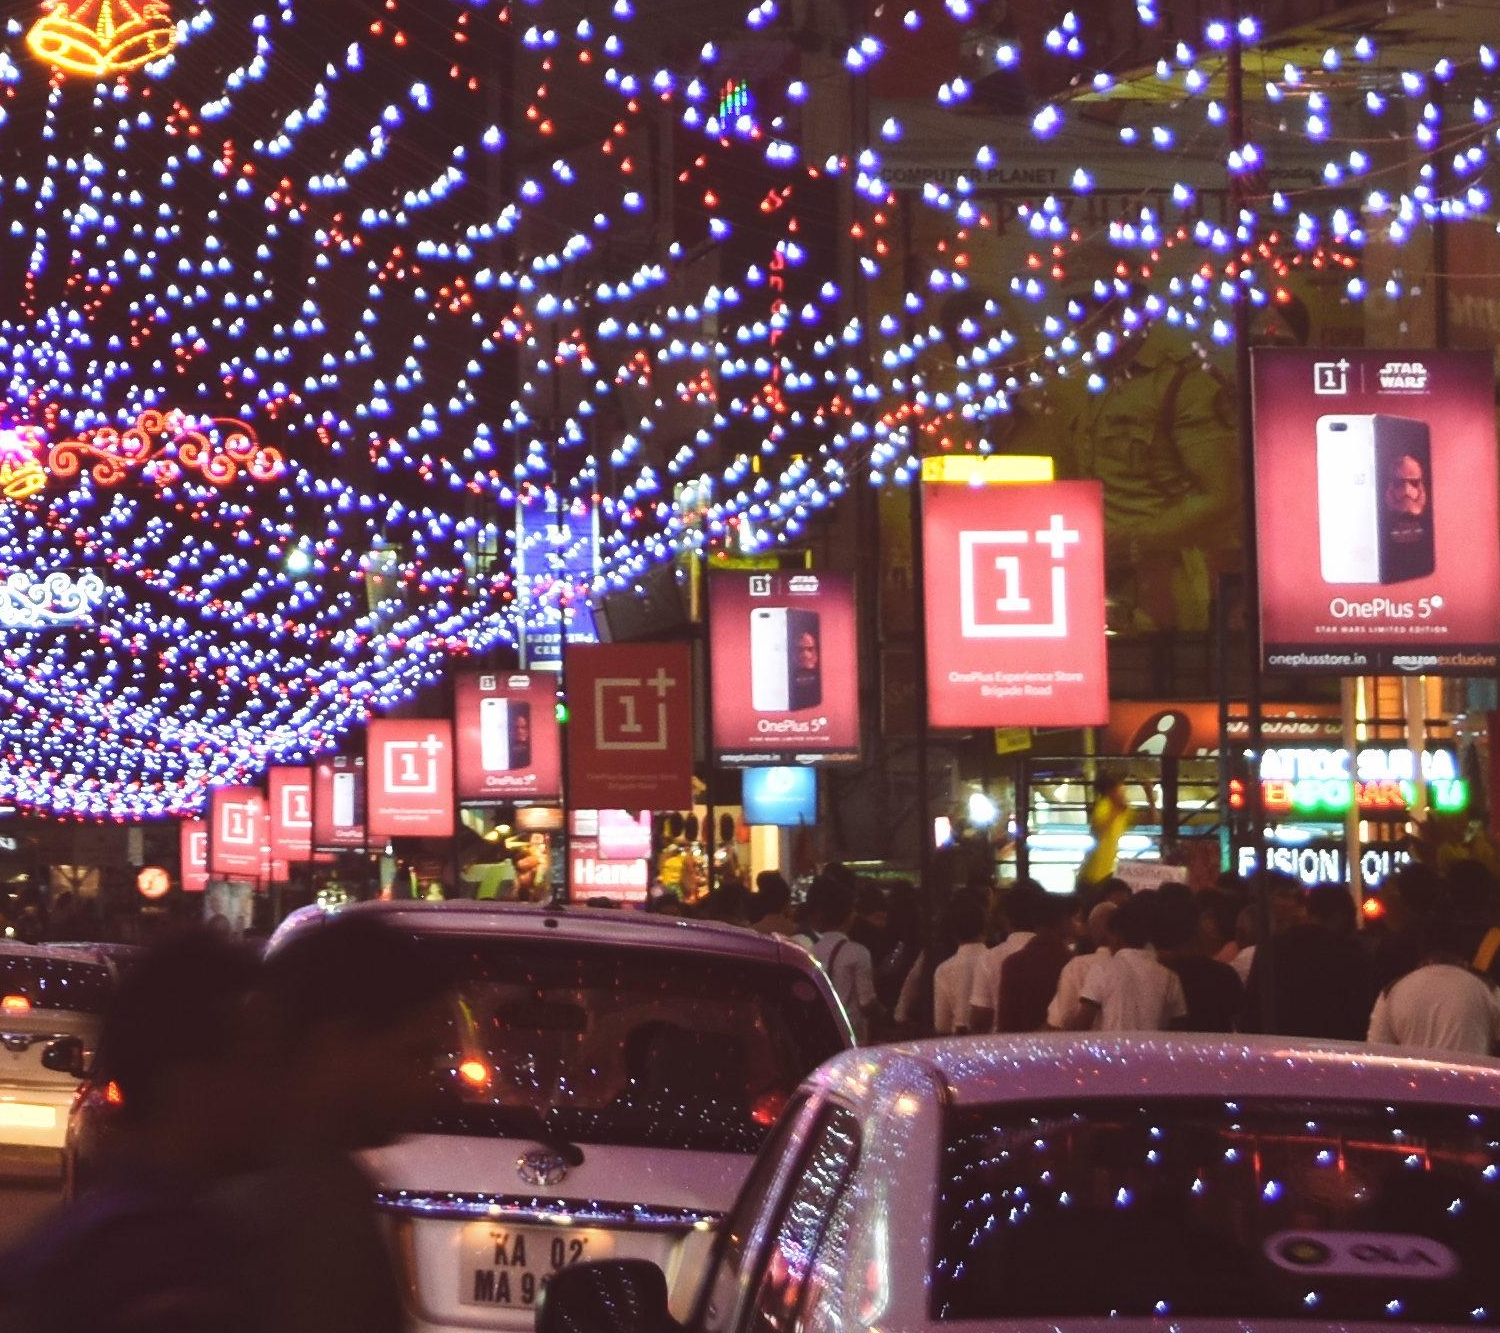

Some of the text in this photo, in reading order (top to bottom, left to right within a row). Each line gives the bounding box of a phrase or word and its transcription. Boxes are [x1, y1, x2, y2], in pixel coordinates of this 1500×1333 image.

[1379, 362, 1427, 375] STAR
[1379, 375, 1427, 390] WARS
[1330, 597, 1414, 620] OnePlus
[1268, 652, 1367, 668] oneplusstore.in
[949, 670, 1084, 685] OnePlus Experience Store
[980, 685, 1053, 699] Brigade Road
[575, 858, 647, 887] Hand
[474, 1269, 511, 1304] MA
